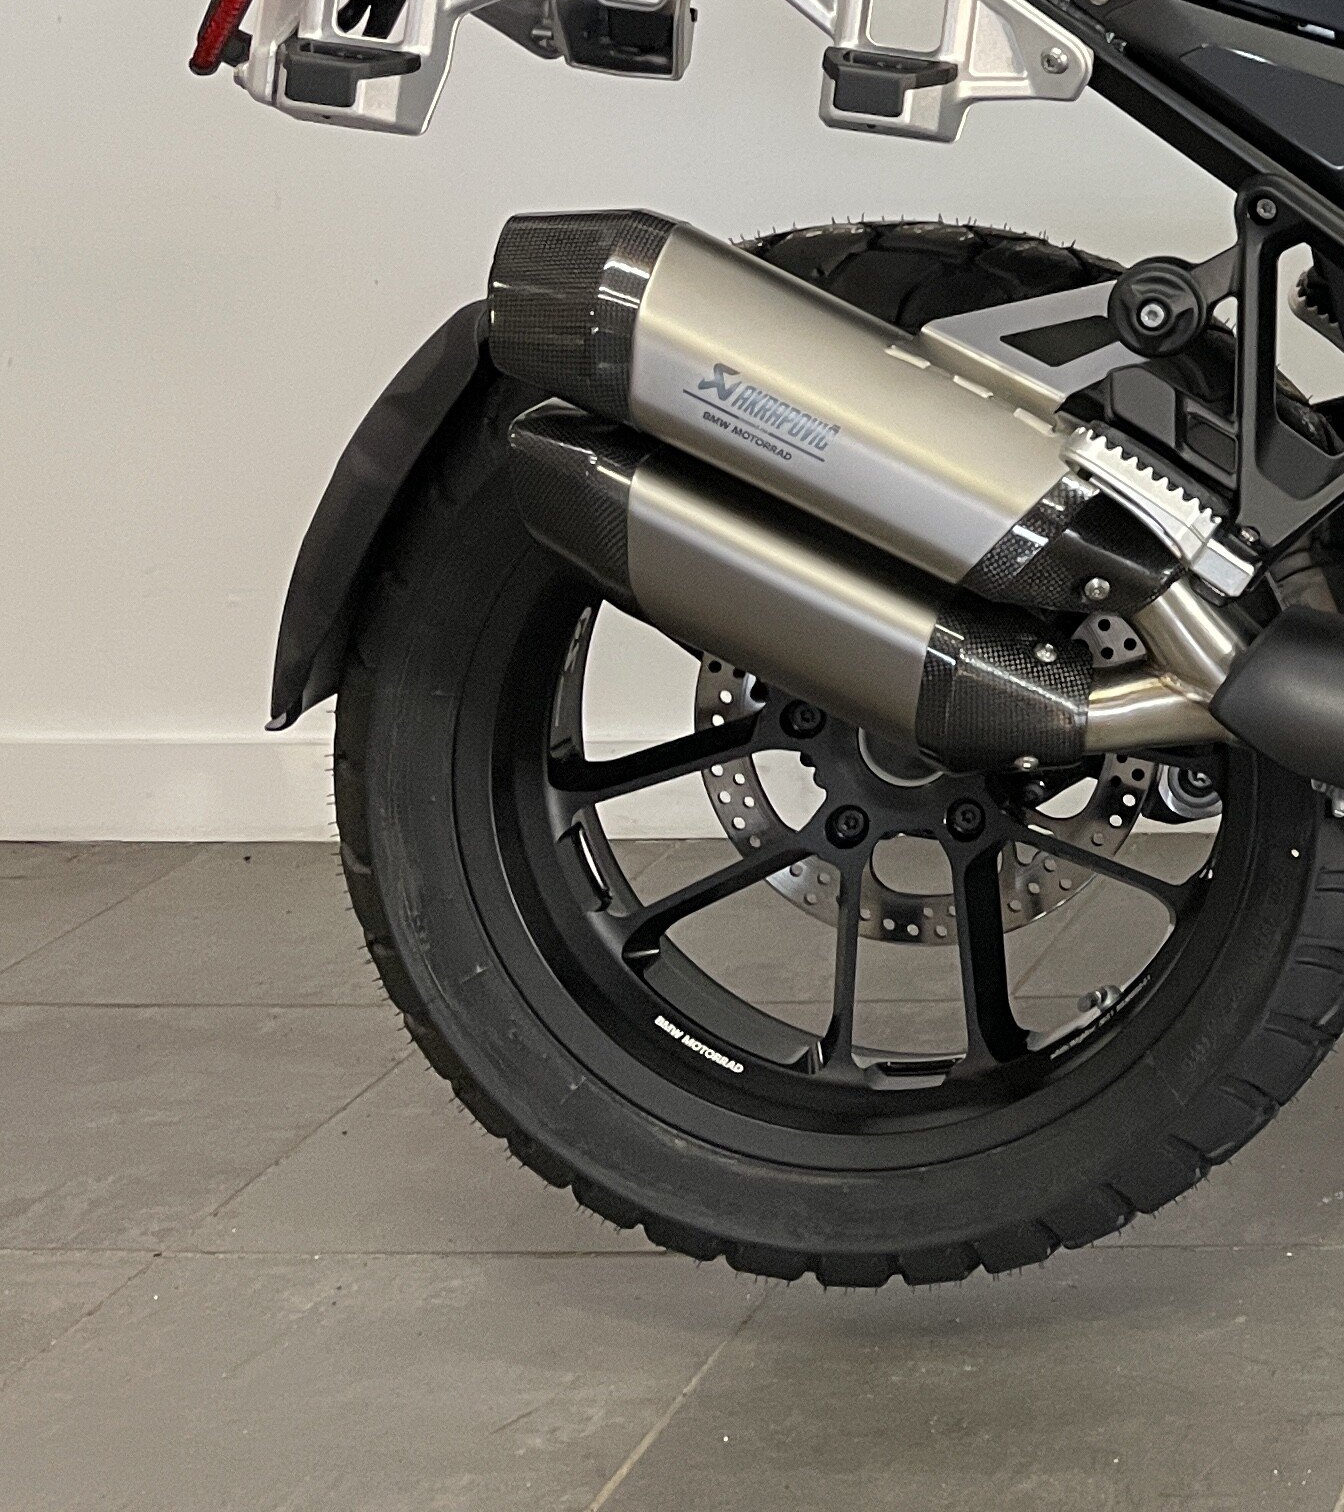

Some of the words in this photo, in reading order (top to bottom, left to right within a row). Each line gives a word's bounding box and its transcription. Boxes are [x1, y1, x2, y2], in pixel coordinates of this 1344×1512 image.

[702, 411, 731, 430] BMW
[731, 425, 792, 461] MOTORRAD
[654, 1015, 685, 1039] BMW
[681, 1034, 744, 1074] MOTORRAD
